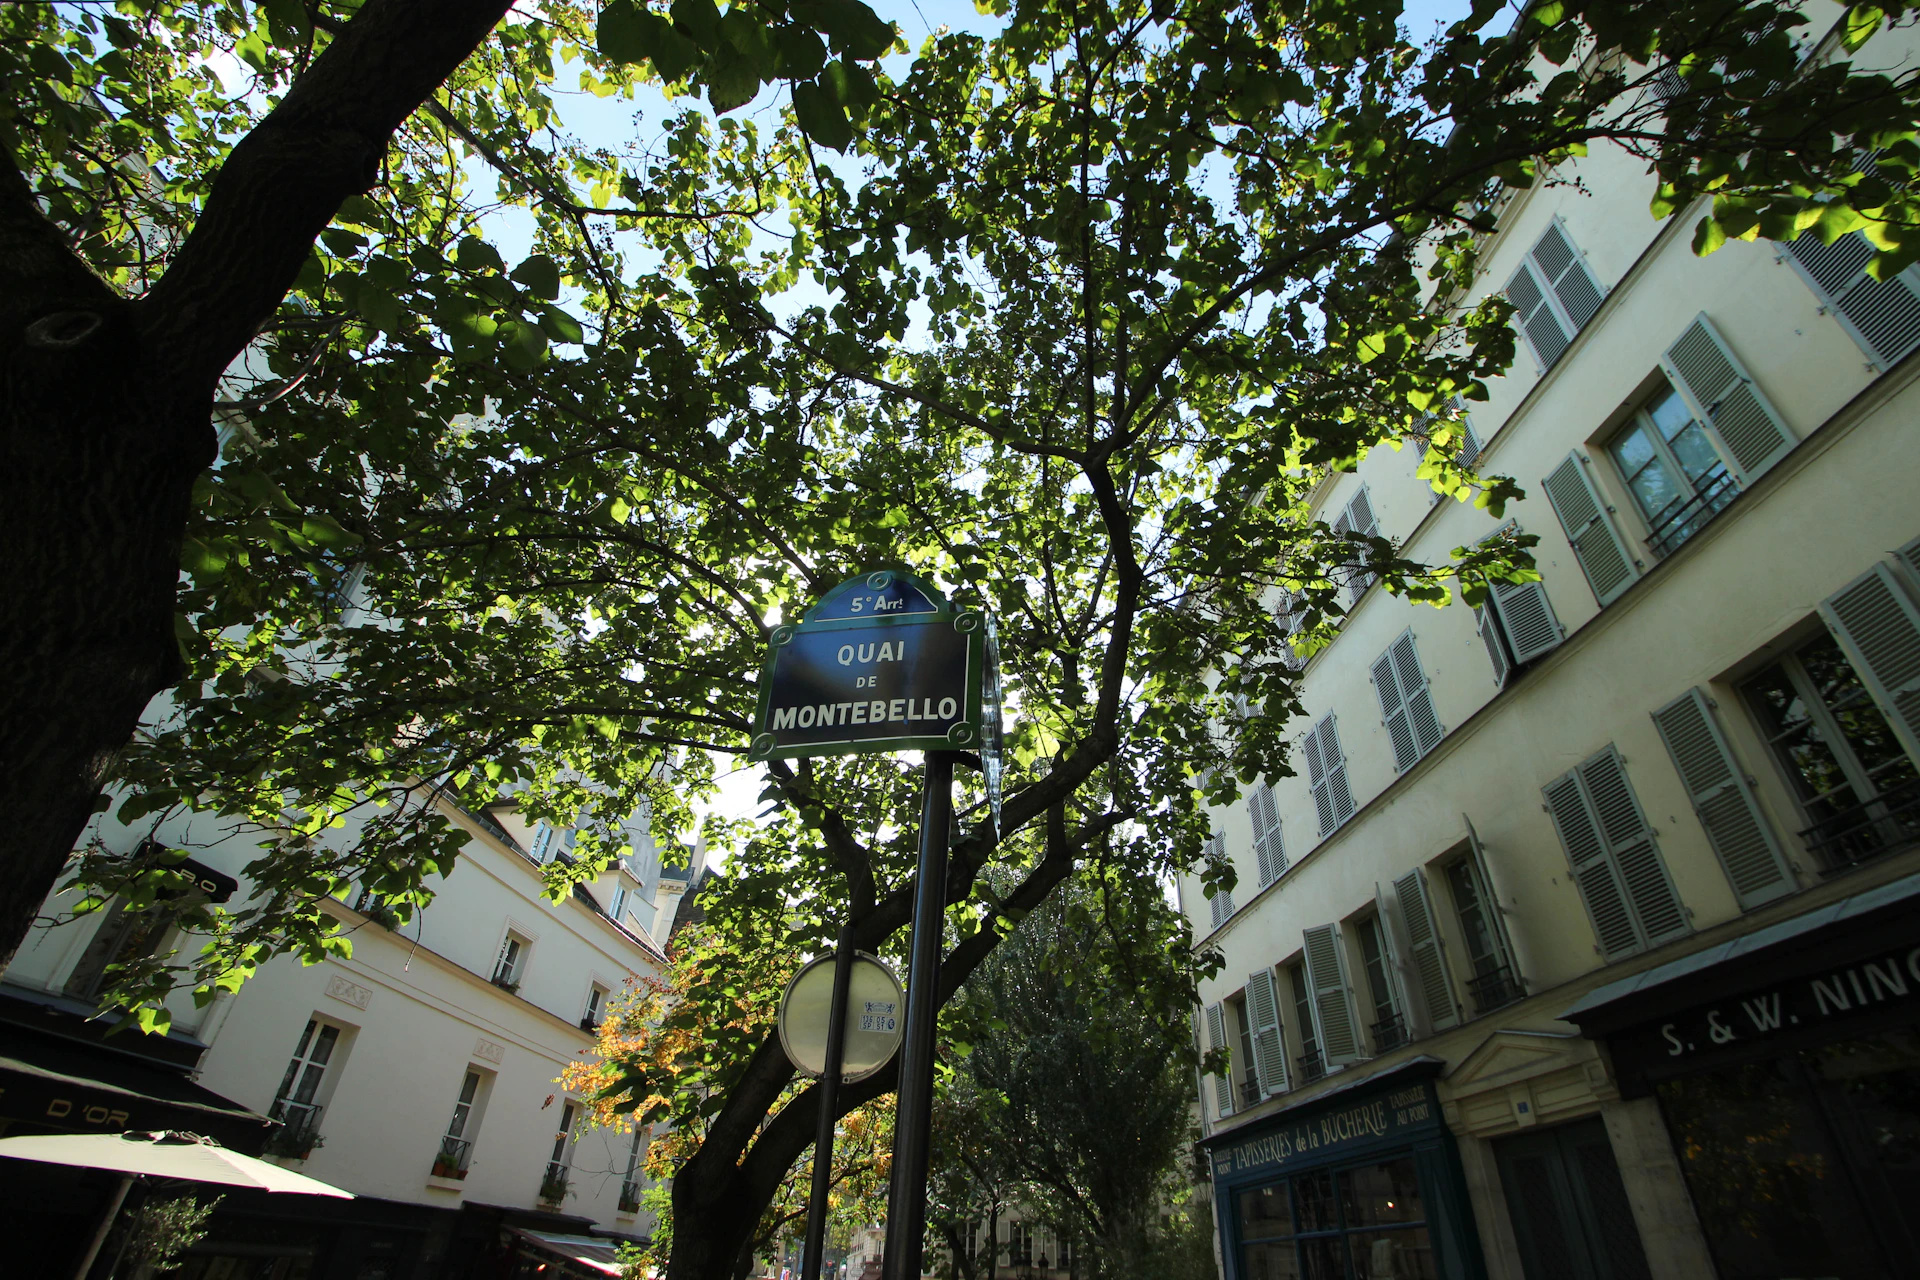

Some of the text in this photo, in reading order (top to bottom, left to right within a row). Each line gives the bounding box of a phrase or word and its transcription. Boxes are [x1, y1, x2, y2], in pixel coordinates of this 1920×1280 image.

[837, 641, 905, 666] QUAI
[856, 676, 877, 689] DE
[772, 697, 957, 731] MONTEBELLO
[1661, 1023, 1695, 1056] S.
[1707, 1009, 1736, 1045] &
[1741, 992, 1799, 1032] W.
[1397, 1103, 1430, 1126] AU POINT
[1233, 1100, 1388, 1164] TAPISSERIES de la BÛCHERIE
